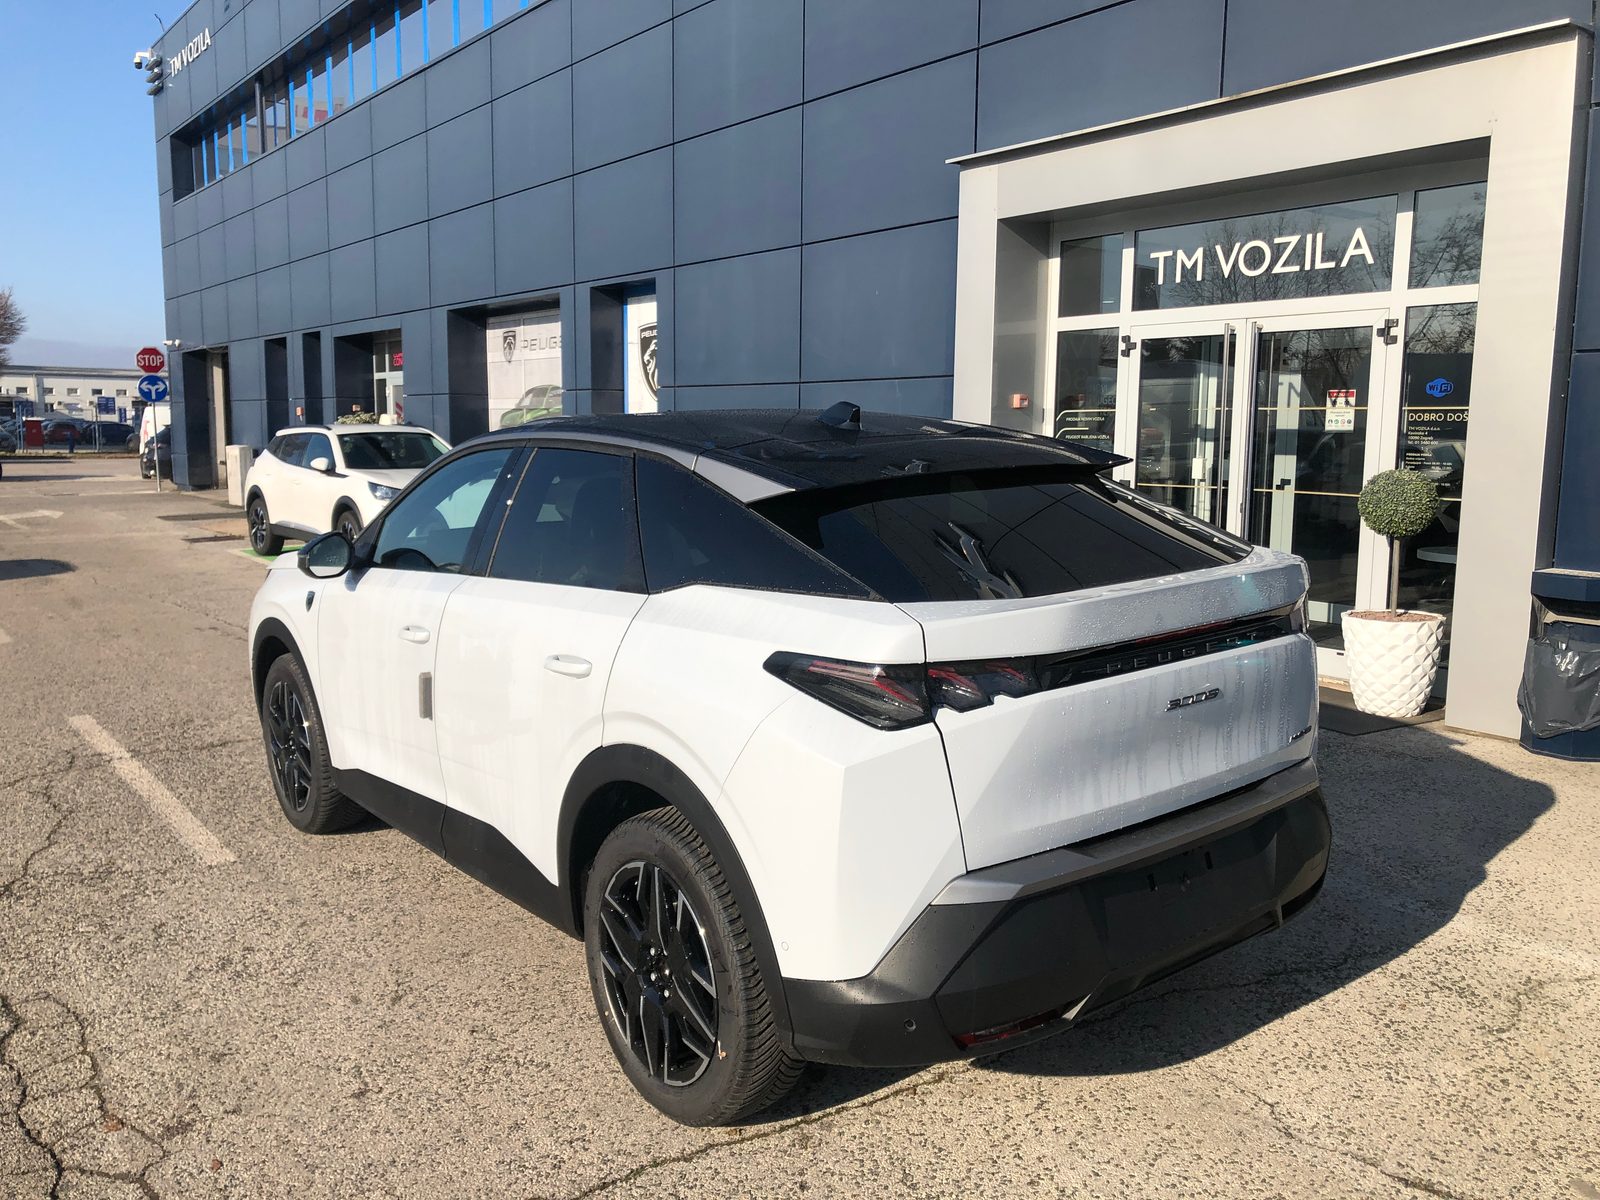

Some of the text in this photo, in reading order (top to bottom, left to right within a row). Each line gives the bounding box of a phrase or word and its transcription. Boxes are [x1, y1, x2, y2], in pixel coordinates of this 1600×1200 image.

[170, 28, 211, 77] TM VOZILA
[1150, 227, 1374, 285] TM VOZILA
[520, 336, 562, 352] PEUG
[137, 355, 164, 366] STOP
[1408, 413, 1445, 421] DOBRO
